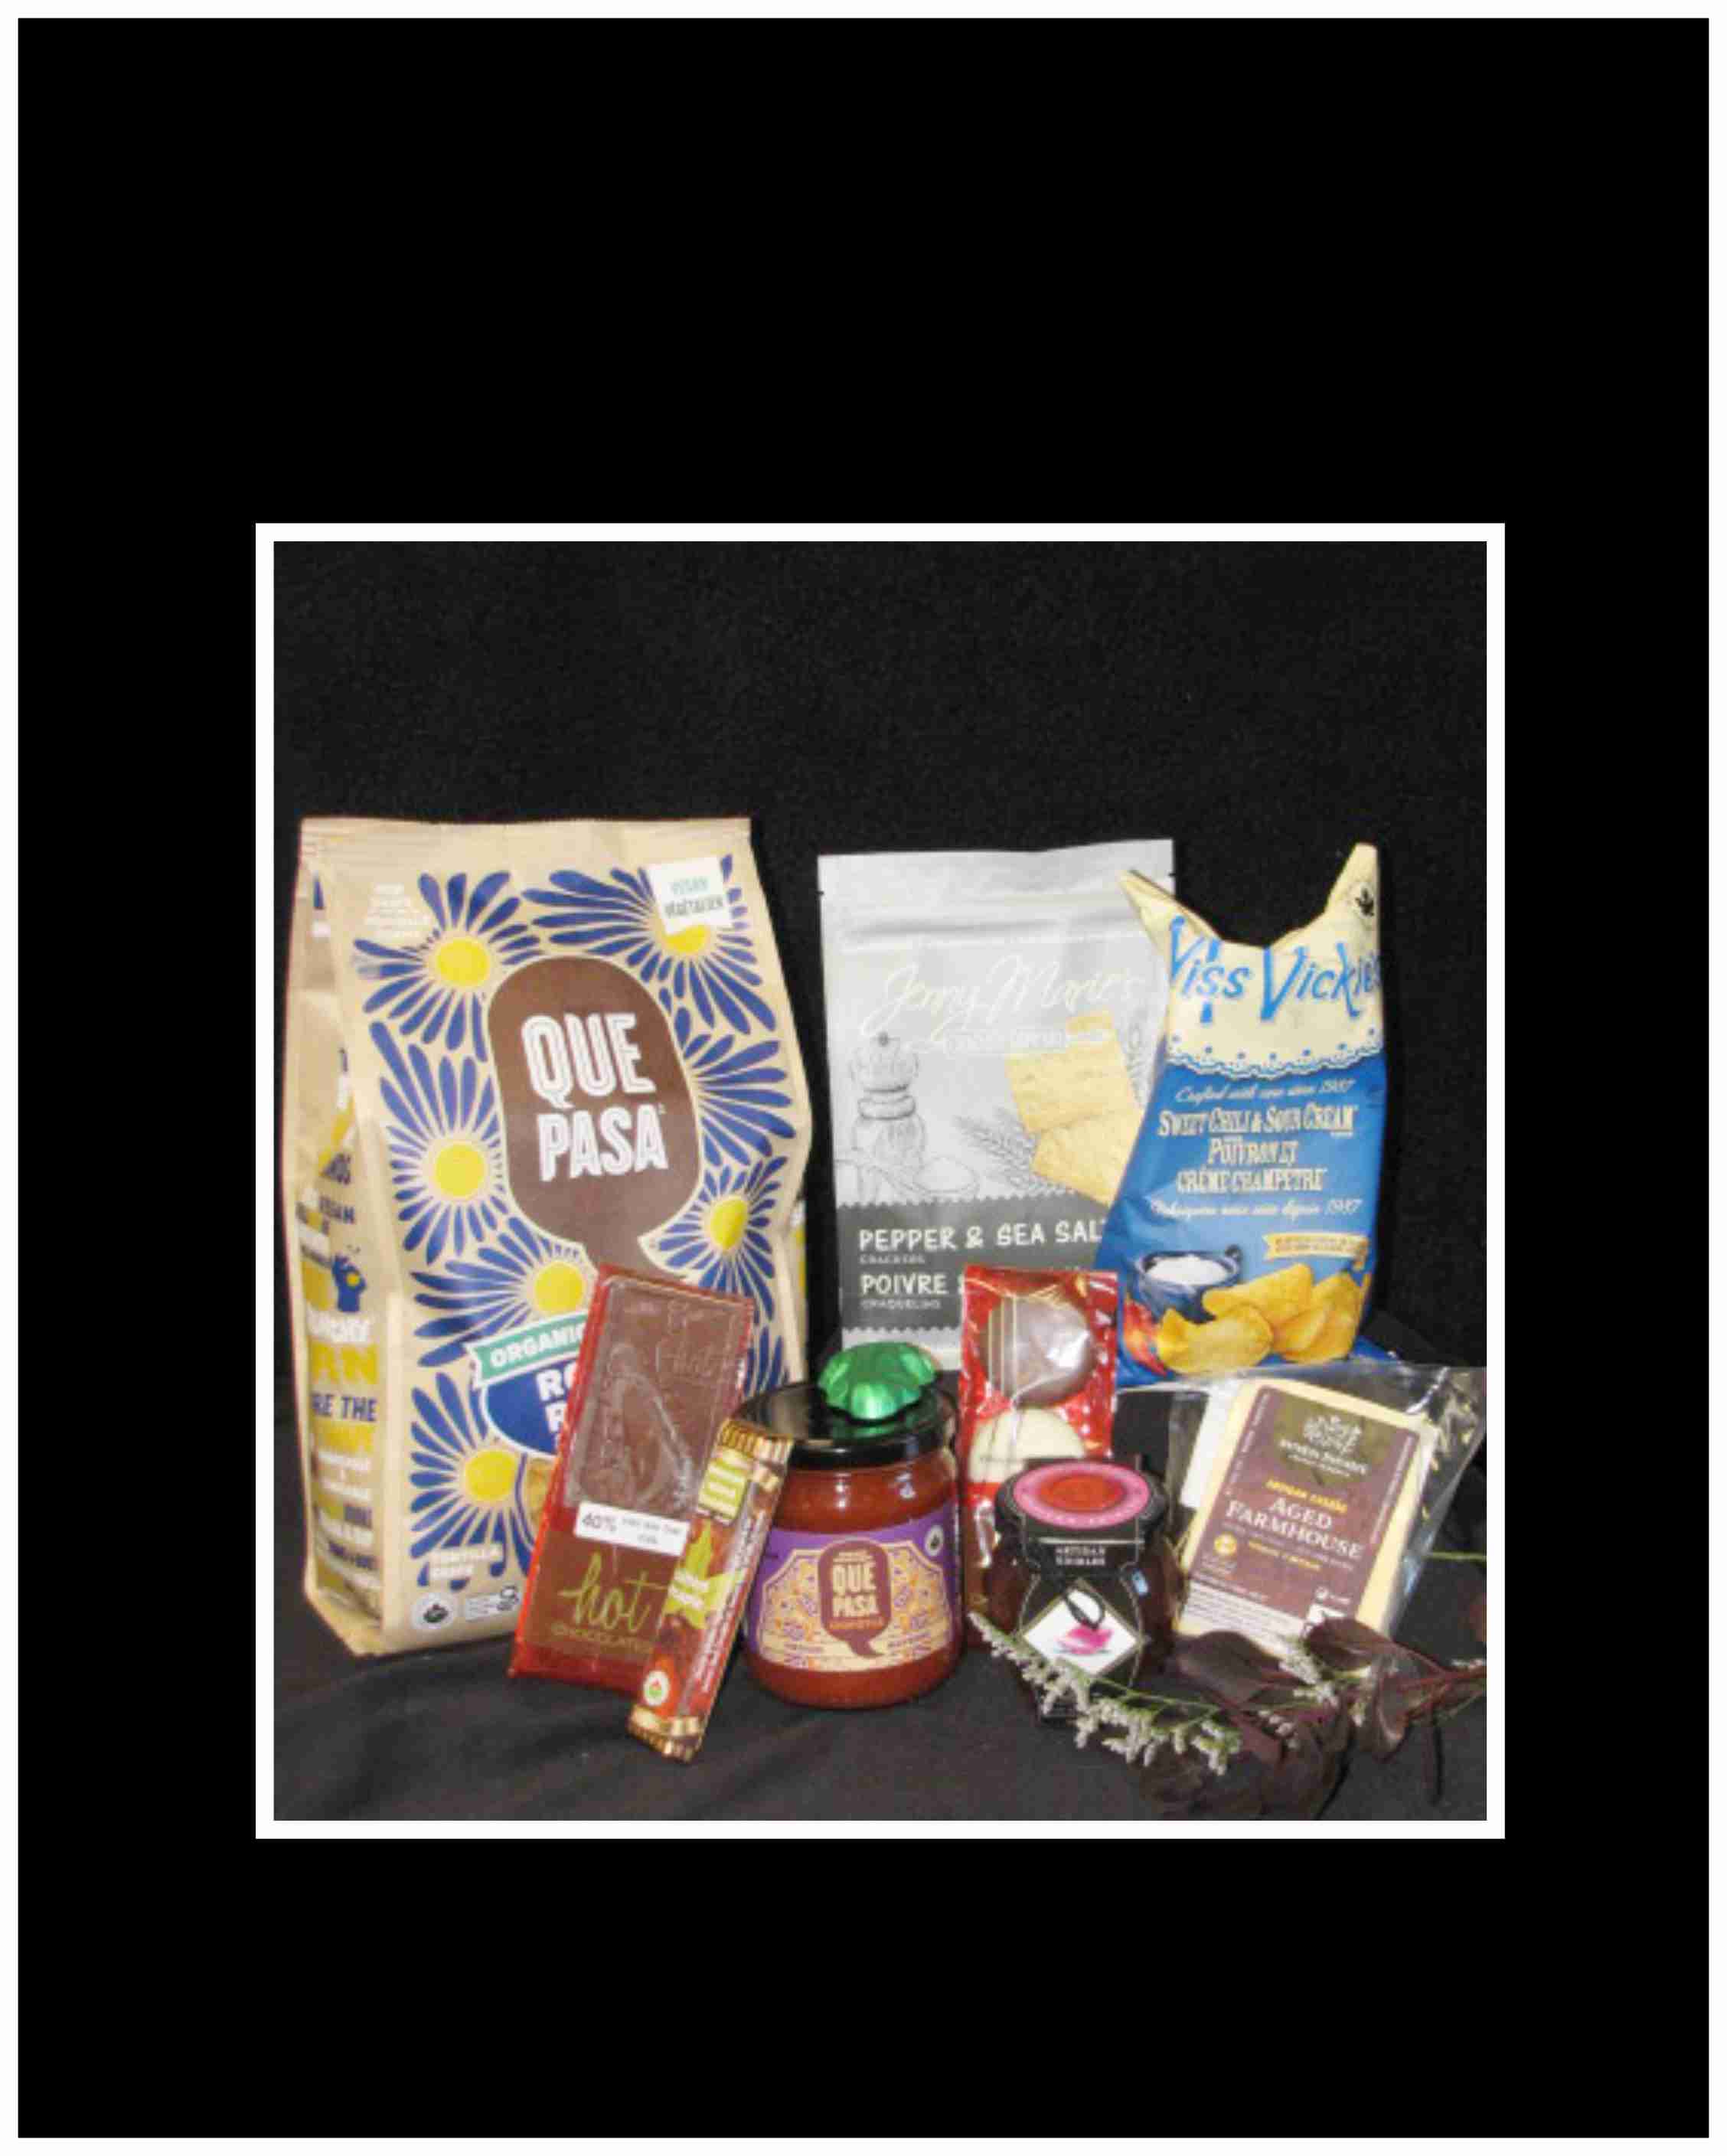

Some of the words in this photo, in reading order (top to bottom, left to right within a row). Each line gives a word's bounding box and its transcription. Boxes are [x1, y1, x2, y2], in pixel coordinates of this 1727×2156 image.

[521, 1012, 656, 1109] QUE
[537, 1103, 668, 1181] PASA
[859, 1227, 956, 1252] PEPPER
[965, 1225, 984, 1249] &
[997, 1223, 1046, 1246] SEA
[1055, 1218, 1106, 1243] SAL
[861, 1273, 948, 1295] POIVRE
[1226, 1500, 1364, 1560] FARMHOUSE
[1269, 1497, 1333, 1530] AGED
[558, 1552, 668, 1634] hot
[832, 1562, 878, 1594] QUE
